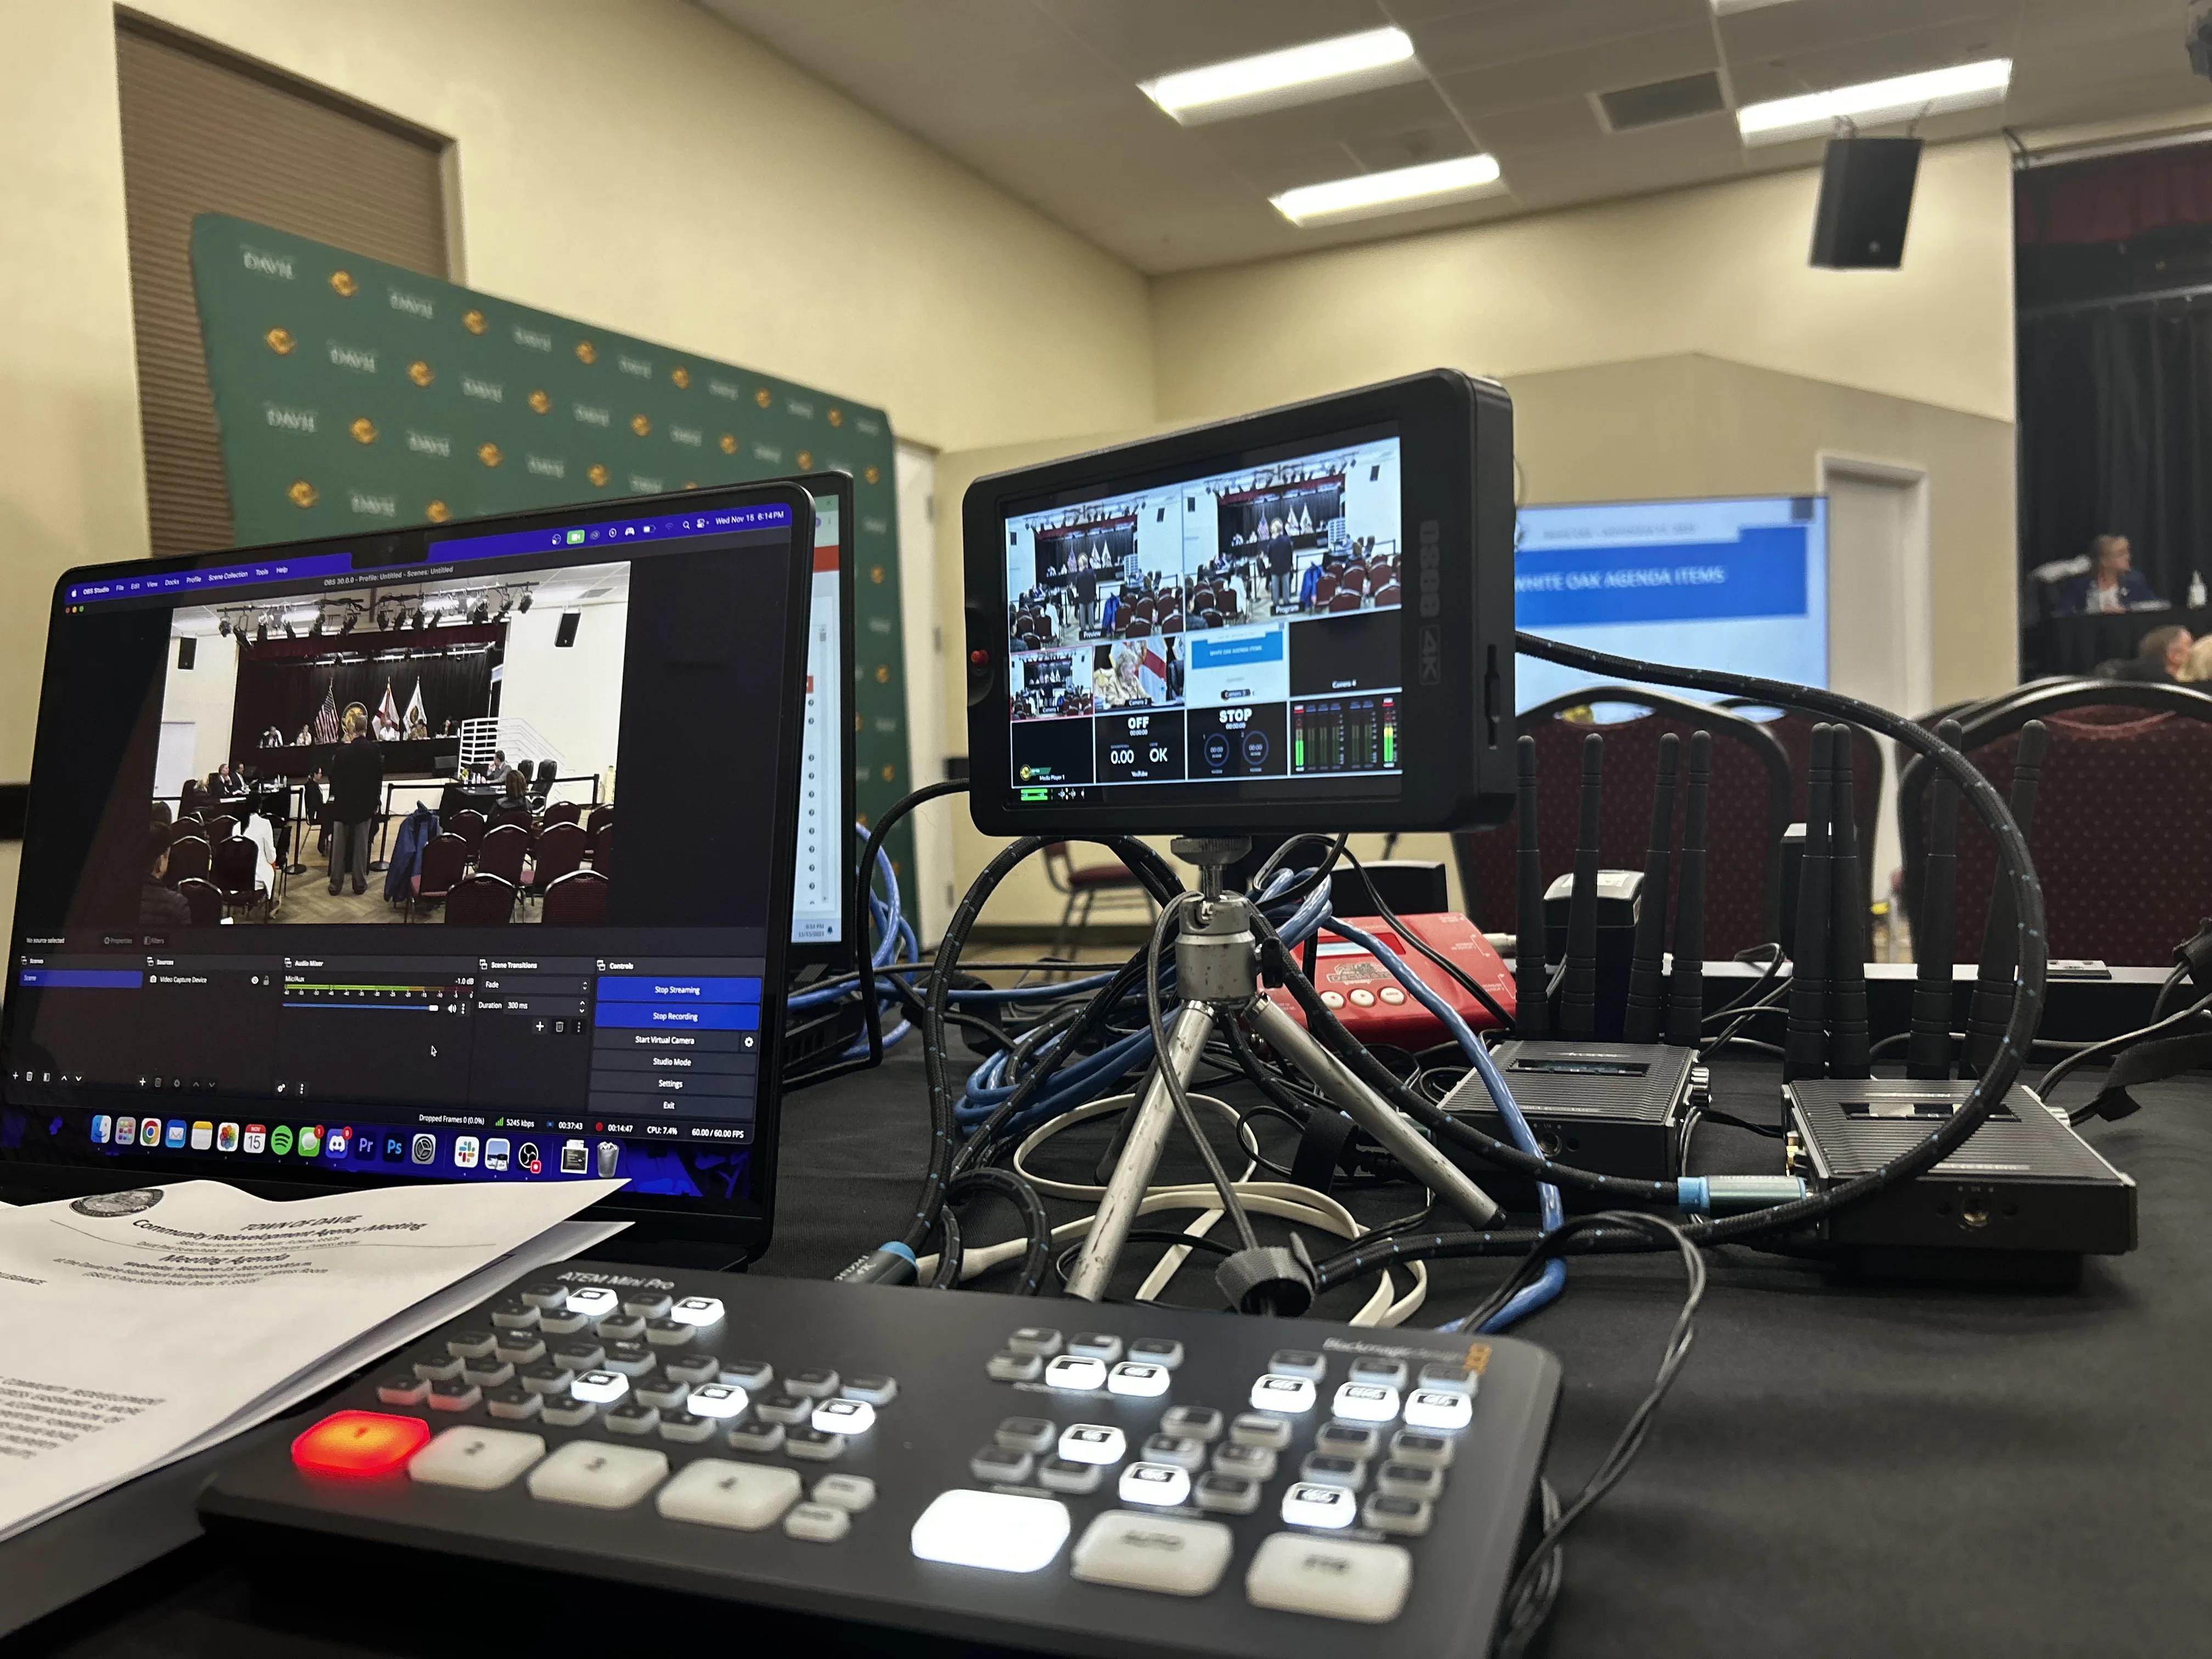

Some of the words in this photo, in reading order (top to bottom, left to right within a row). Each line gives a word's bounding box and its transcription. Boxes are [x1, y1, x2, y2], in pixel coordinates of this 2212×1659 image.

[715, 516, 730, 525] Wed
[731, 515, 744, 523] Nov
[757, 512, 772, 521] 6:14
[773, 510, 784, 519] PM
[208, 573, 223, 582] Scene
[224, 571, 249, 580] Collection
[256, 568, 269, 577] Tools
[337, 577, 354, 585] 30.0.0
[359, 575, 379, 583] Profile:
[380, 571, 402, 580] Untitled
[407, 569, 430, 578] Scenes:
[431, 566, 454, 574] Untitled
[165, 578, 179, 586] Docks
[186, 575, 201, 584] Profile
[1565, 571, 1601, 591] OAK
[1604, 567, 1673, 588] AGENDA
[1674, 565, 1726, 585] ITEMS
[94, 585, 109, 594] Studio
[1276, 605, 1300, 614] Program
[1084, 630, 1102, 639] Preview
[1421, 629, 1438, 682] 4K
[1219, 708, 1252, 724] STOP
[1127, 716, 1150, 729] OFF
[1110, 749, 1135, 765] 0.00
[1149, 747, 1168, 763] OK
[173, 976, 191, 984] Capture
[655, 986, 669, 995] Stop
[670, 986, 701, 996] Streaming
[478, 1001, 503, 1009] Duration
[653, 1012, 667, 1021] Stop
[668, 1012, 698, 1022] Recording
[651, 1036, 670, 1044] Virtual
[671, 1037, 695, 1045] Camera
[653, 1057, 673, 1066] Studio
[674, 1058, 692, 1066] Mode
[658, 1079, 683, 1090] Settings
[663, 1101, 675, 1110] Exit
[419, 1114, 442, 1123] Dropped
[443, 1115, 462, 1124] Frames
[467, 1117, 484, 1125] (0.0%)
[506, 1118, 520, 1127] 5245
[521, 1119, 534, 1128] kbps
[558, 1121, 583, 1130] 00:37:43
[608, 1124, 633, 1132] 00:14:47
[647, 1126, 662, 1135] CPU:
[663, 1126, 678, 1135] 7.4%
[692, 1128, 709, 1137] 60.00
[714, 1129, 731, 1138] 60.00
[732, 1130, 744, 1138] FPS
[248, 1135, 261, 1149] 15
[359, 1138, 374, 1153] Pr
[387, 1139, 402, 1154] Ps
[311, 1215, 363, 1226] DAVIE
[133, 1220, 212, 1240] Community
[363, 1222, 428, 1232] Meeting
[159, 1254, 229, 1266] Meeting
[556, 1271, 609, 1284] ATEM
[607, 1275, 646, 1287] Mini
[644, 1277, 675, 1290] Pro
